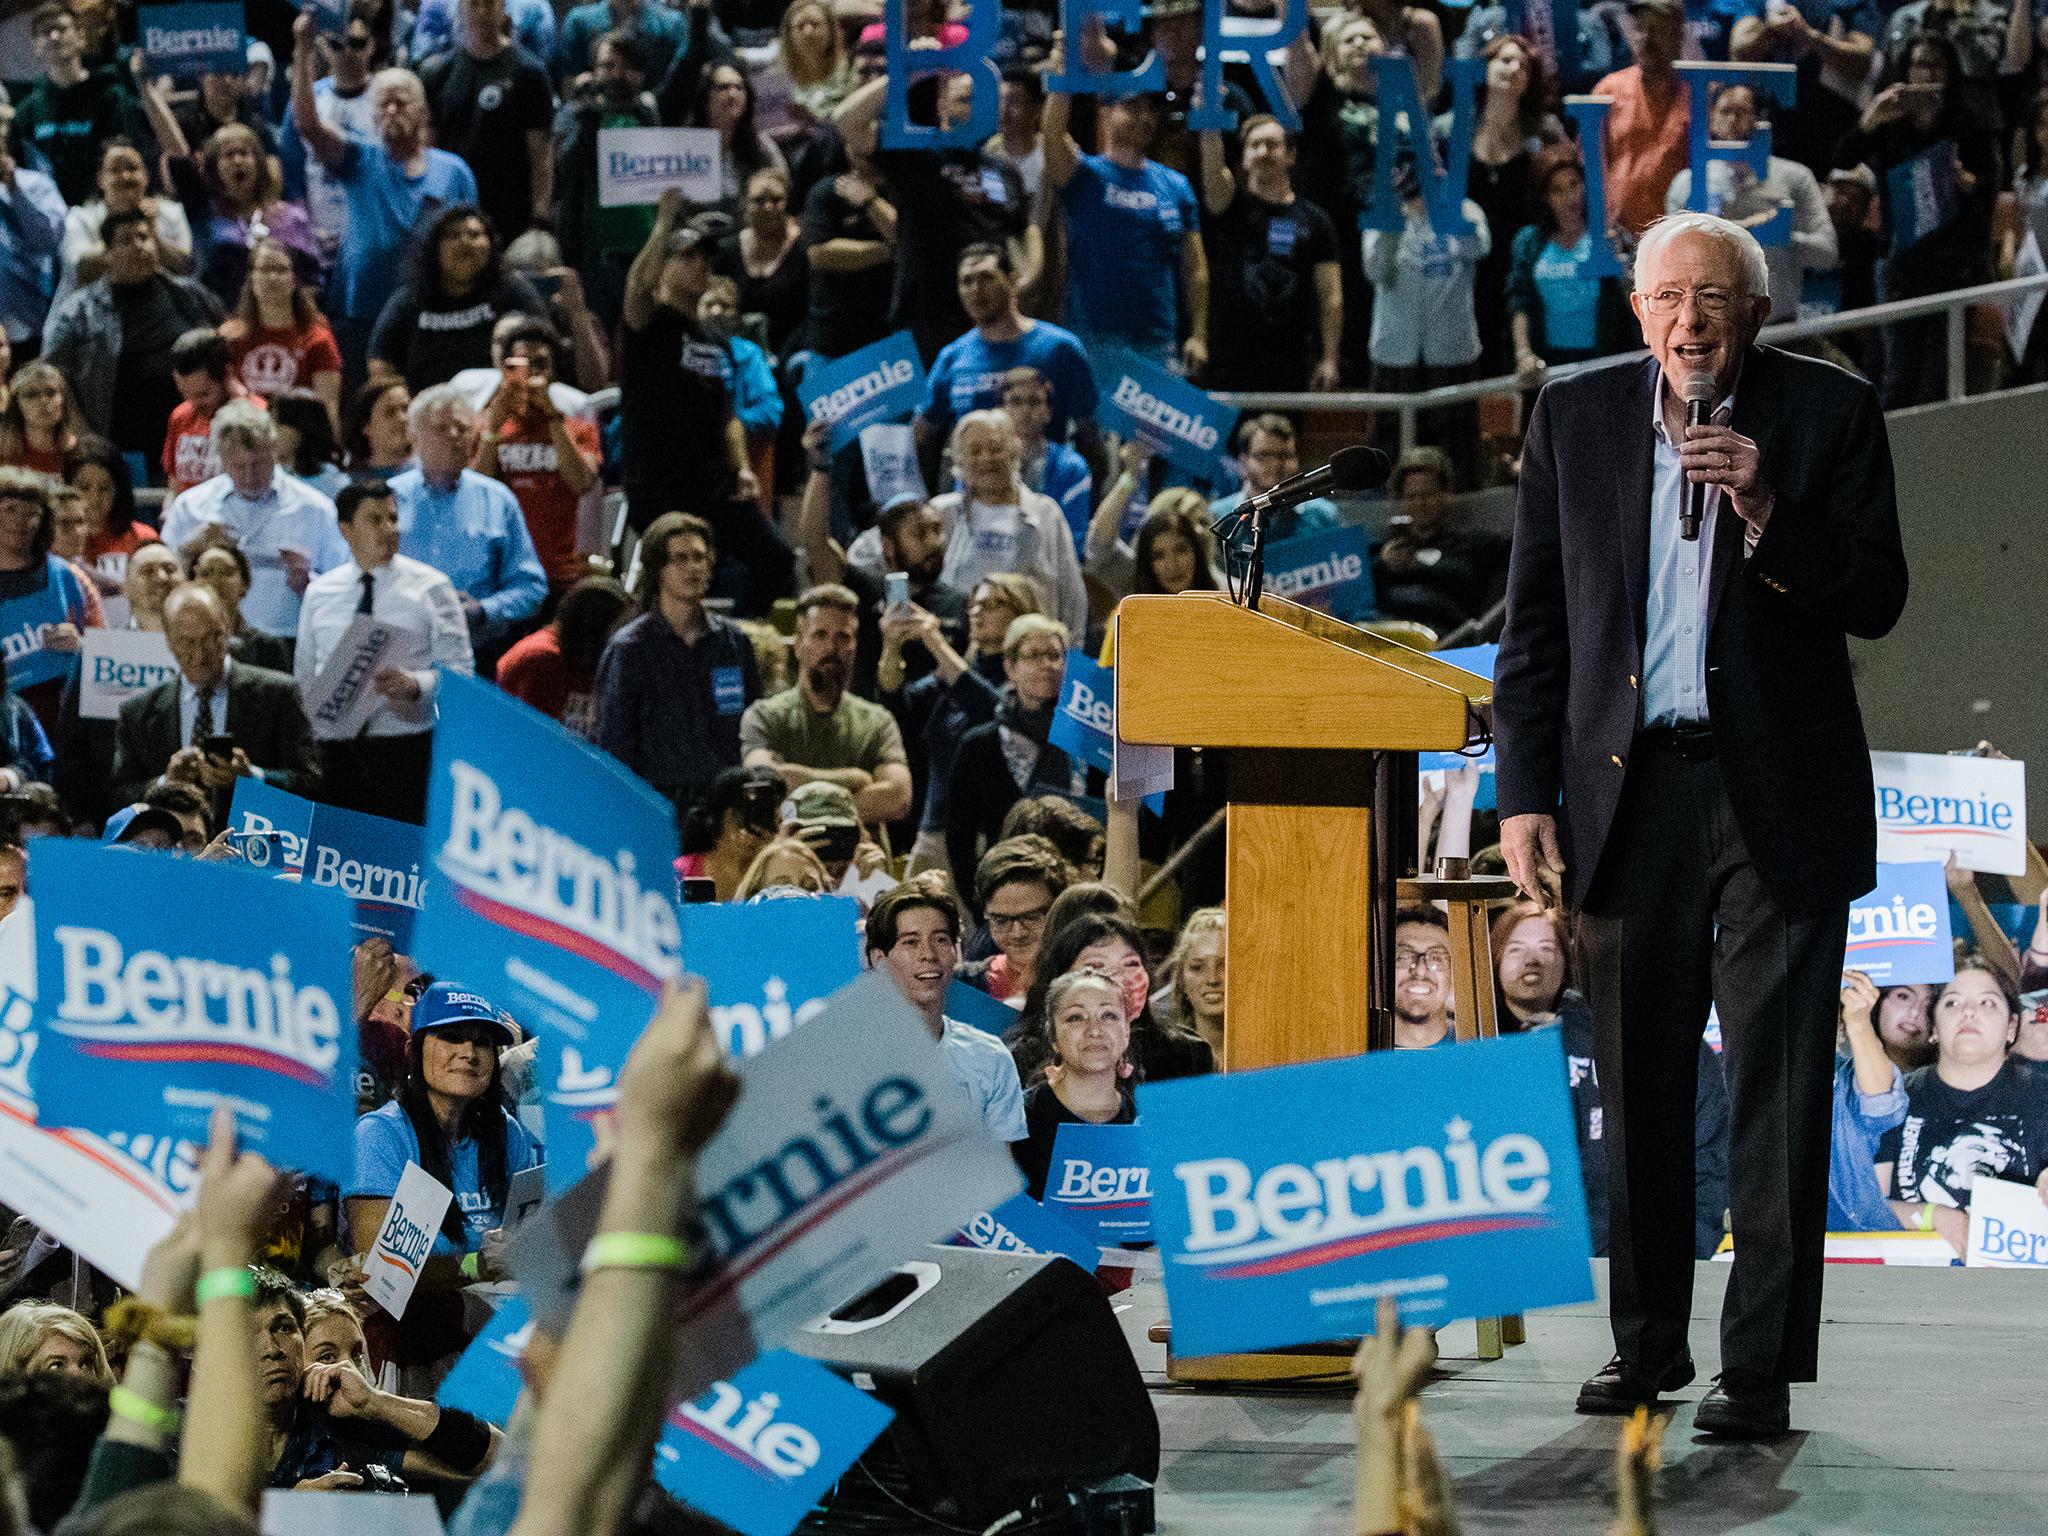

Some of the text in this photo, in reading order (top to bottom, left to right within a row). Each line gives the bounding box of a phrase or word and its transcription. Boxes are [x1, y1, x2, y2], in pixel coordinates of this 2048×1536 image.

[146, 26, 240, 53] Bernie
[609, 150, 712, 177] Bernie
[809, 359, 913, 420] Bernie
[1111, 375, 1218, 449] Bernie
[317, 629, 388, 721] Bernie
[1877, 786, 2013, 830] Bernie
[442, 760, 682, 973] Bernie
[54, 925, 340, 1069] Bernie
[700, 1075, 933, 1257] rnie
[1173, 1115, 1551, 1252] Bernie
[382, 1202, 431, 1268] Bernie
